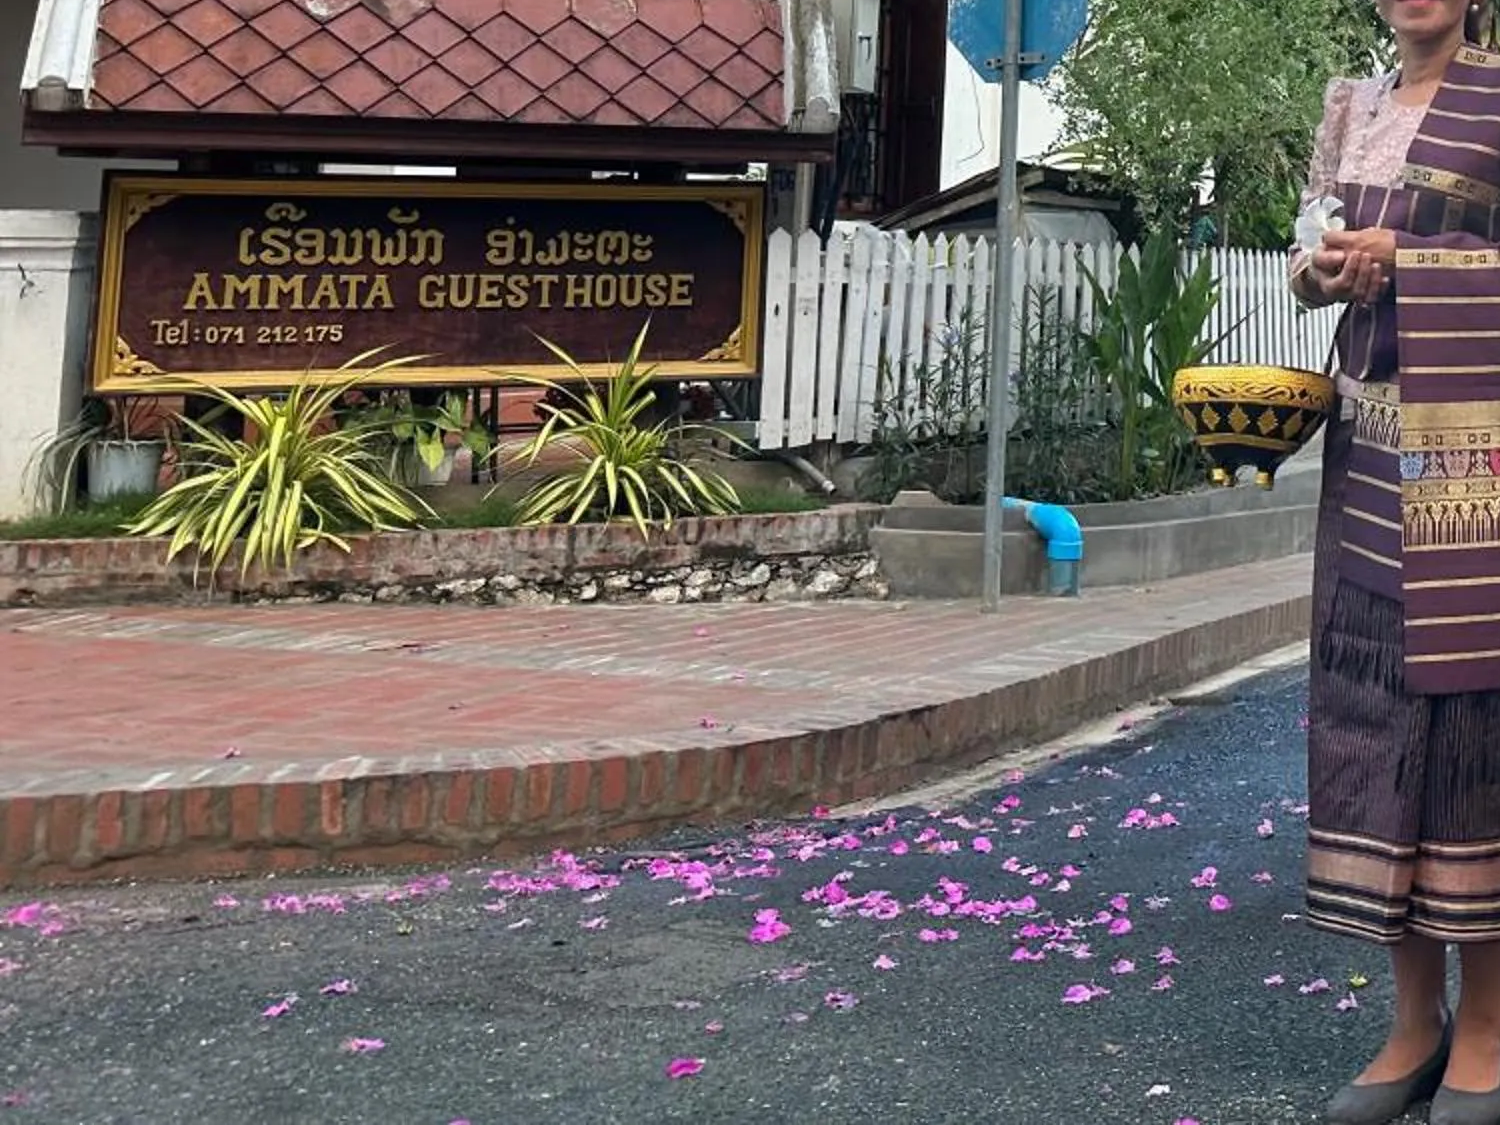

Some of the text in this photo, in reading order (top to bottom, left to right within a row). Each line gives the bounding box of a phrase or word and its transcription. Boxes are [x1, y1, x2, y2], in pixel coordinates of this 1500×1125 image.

[183, 272, 394, 310] AMMATA
[205, 326, 246, 344] 071
[256, 326, 299, 343] 212
[304, 324, 344, 342] 175
